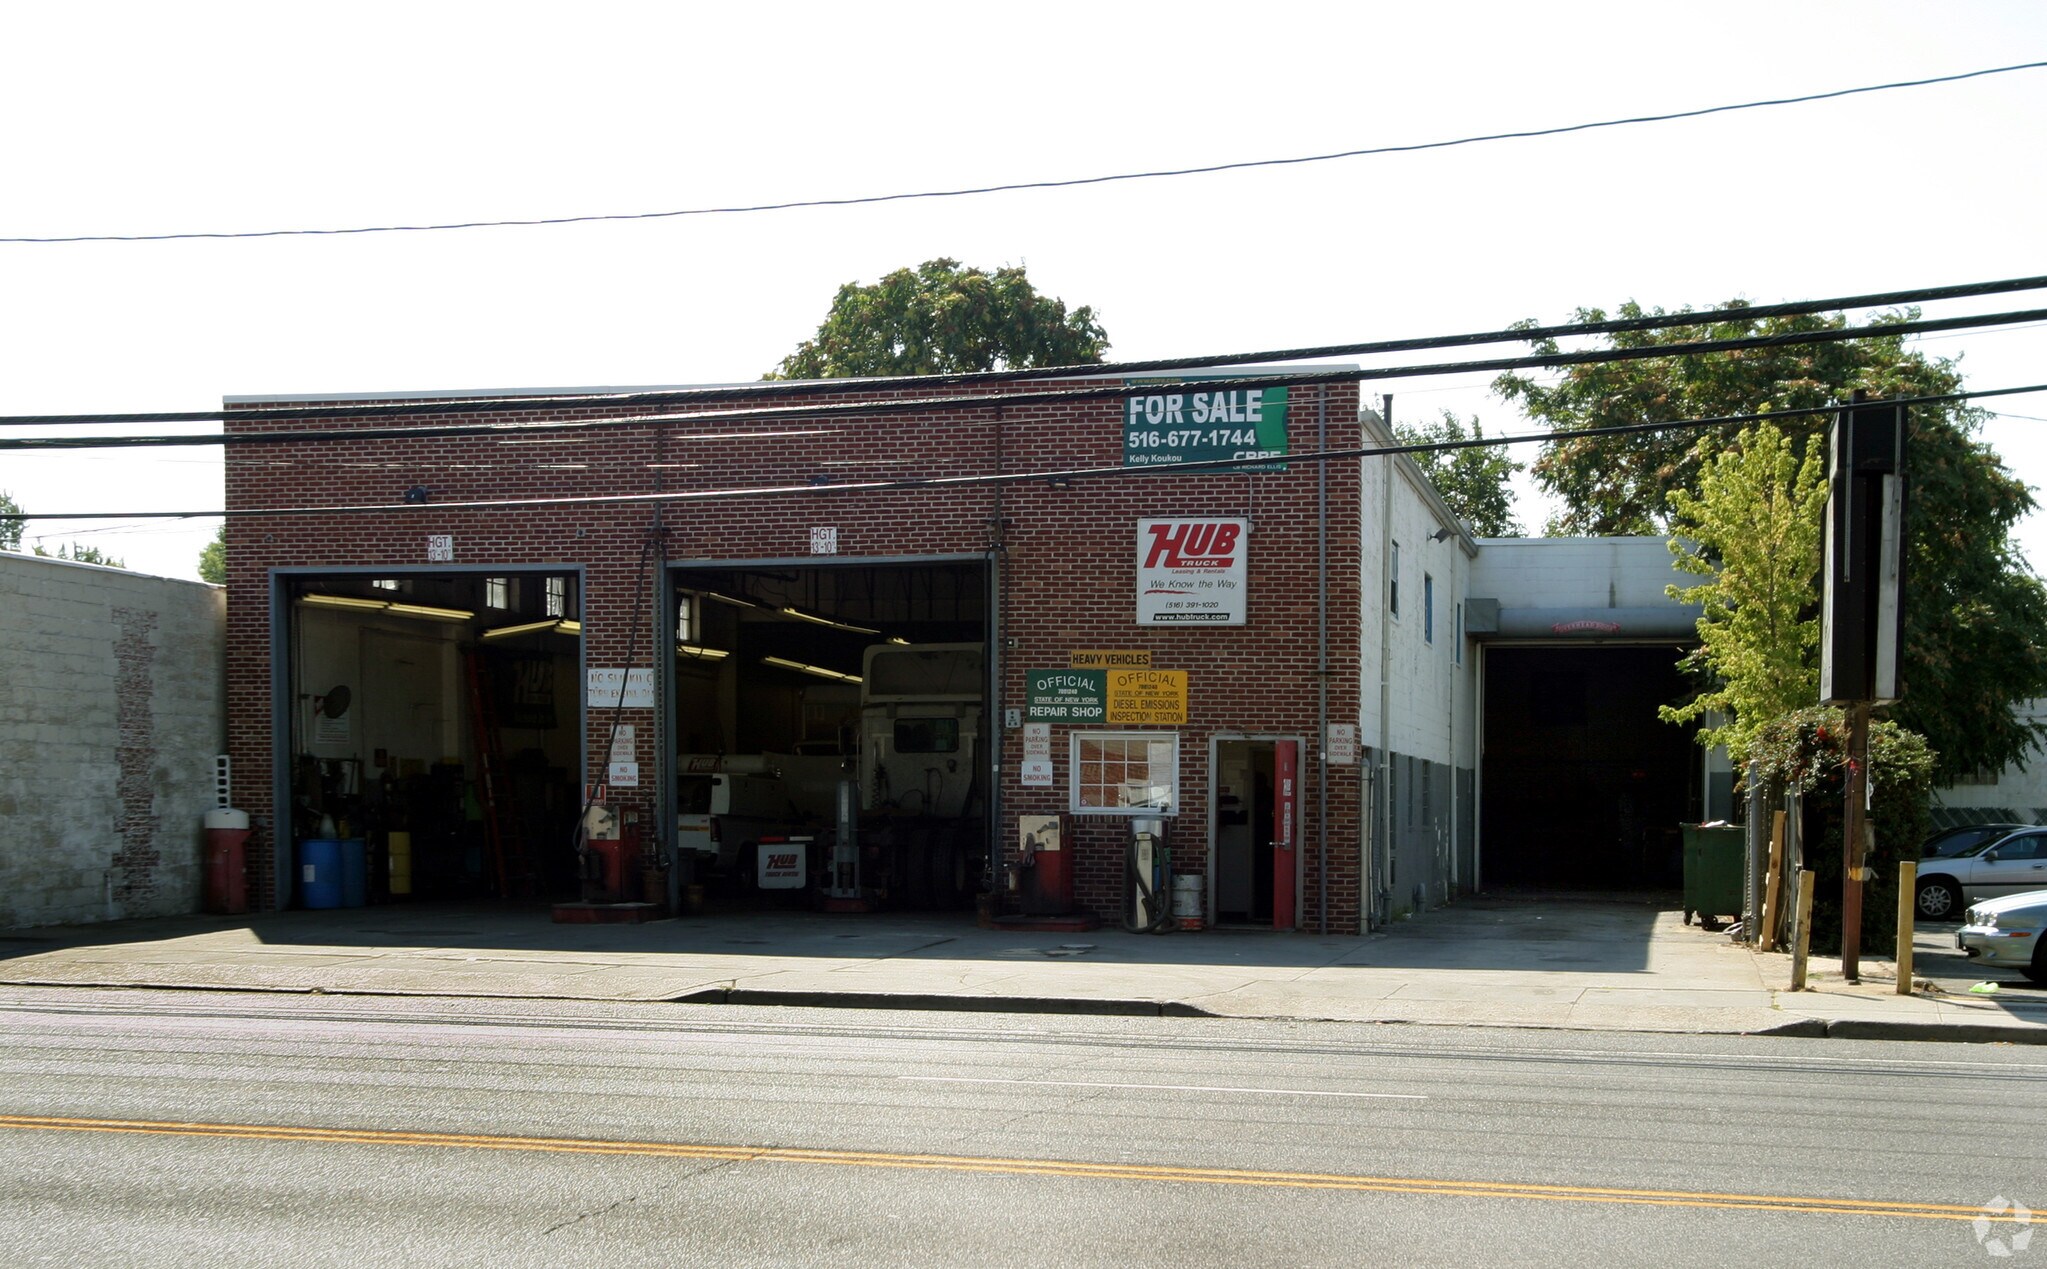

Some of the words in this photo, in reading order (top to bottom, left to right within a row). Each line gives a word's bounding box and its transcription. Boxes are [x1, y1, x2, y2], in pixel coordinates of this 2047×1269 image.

[1129, 393, 1184, 425] FOR
[1192, 389, 1263, 424] SALE
[1129, 429, 1256, 448] 516-677-1744
[1129, 454, 1149, 464] Kelly
[1151, 453, 1182, 463] Koukou
[812, 528, 836, 540] HGT.
[1143, 523, 1241, 568] HUB
[1181, 559, 1219, 567] TRUCK
[1150, 580, 1165, 588] We
[1168, 580, 1195, 588] Know
[1199, 579, 1213, 588] the
[1217, 579, 1238, 589] Way
[1165, 601, 1184, 609] (516)
[1072, 654, 1102, 665] HEAVY
[1105, 653, 1149, 665] VEHICLES
[1037, 675, 1096, 691] OFFICIAL
[1116, 671, 1177, 687] OFFICIAL
[1113, 700, 1138, 710] DIESEL
[1140, 699, 1180, 710] EMISSIONS
[1030, 707, 1068, 717] REPAIR
[1071, 706, 1103, 717] SHOP
[1110, 712, 1151, 722] INSPECTION
[1155, 711, 1183, 722] STATION
[611, 774, 637, 782] SMOKING
[767, 854, 798, 869] HUB
